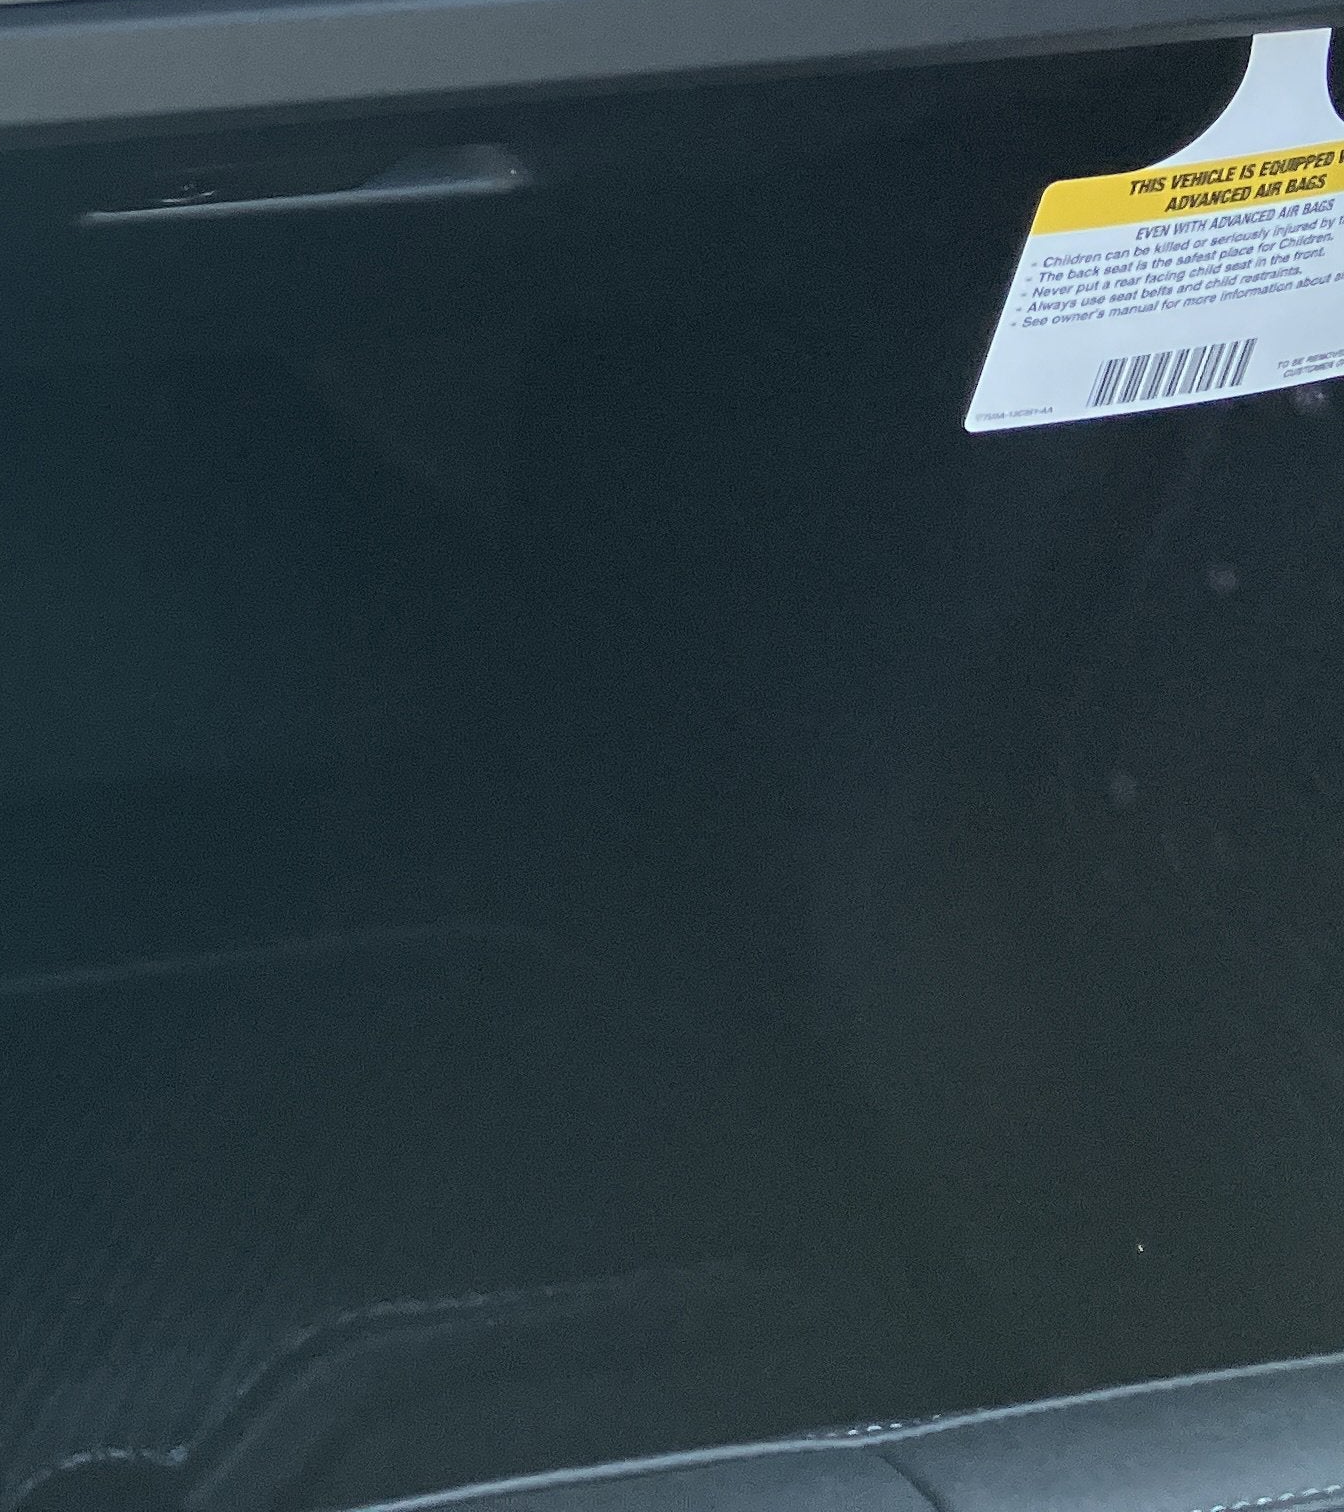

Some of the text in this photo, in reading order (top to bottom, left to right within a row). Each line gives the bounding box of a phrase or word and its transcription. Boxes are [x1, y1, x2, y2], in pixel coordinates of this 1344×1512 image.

[1129, 176, 1167, 195] THIS
[1171, 166, 1238, 190] VEHICLE
[1239, 163, 1257, 180] IS
[1258, 150, 1335, 177] EQUIPPED
[1164, 173, 1328, 213] ADVANCED AIR BAGS
[1043, 253, 1103, 269] Children
[1105, 249, 1131, 261] can
[1133, 246, 1151, 257] be
[1153, 239, 1191, 255] killed
[1192, 239, 1207, 249] or
[1209, 227, 1270, 247] seriously
[1272, 220, 1319, 238] injured
[1319, 215, 1337, 230] by
[1135, 198, 1336, 241] EVEN WITH ADVANCED AIR BAGS
[1031, 285, 1074, 299] Never
[1075, 280, 1101, 296] put
[1101, 280, 1112, 290] a
[1114, 274, 1143, 289] rear
[1145, 269, 1187, 286] facing
[1188, 262, 1224, 279] child
[1224, 258, 1254, 272] seat
[1254, 256, 1268, 268] in
[1269, 252, 1291, 266] the
[1039, 232, 1336, 284] The back seat is the safest place for Children.
[1021, 316, 1049, 328] See
[1051, 308, 1106, 325] owner's
[1108, 300, 1160, 318] manual
[1160, 299, 1181, 312] for
[1182, 294, 1217, 308] more
[1218, 281, 1294, 302] information
[1295, 272, 1333, 290] about
[1026, 299, 1078, 314] Always
[1080, 296, 1107, 307] use
[1108, 291, 1139, 304] seat
[1140, 284, 1174, 300] belts
[1175, 281, 1204, 294] and
[1204, 275, 1242, 290] child
